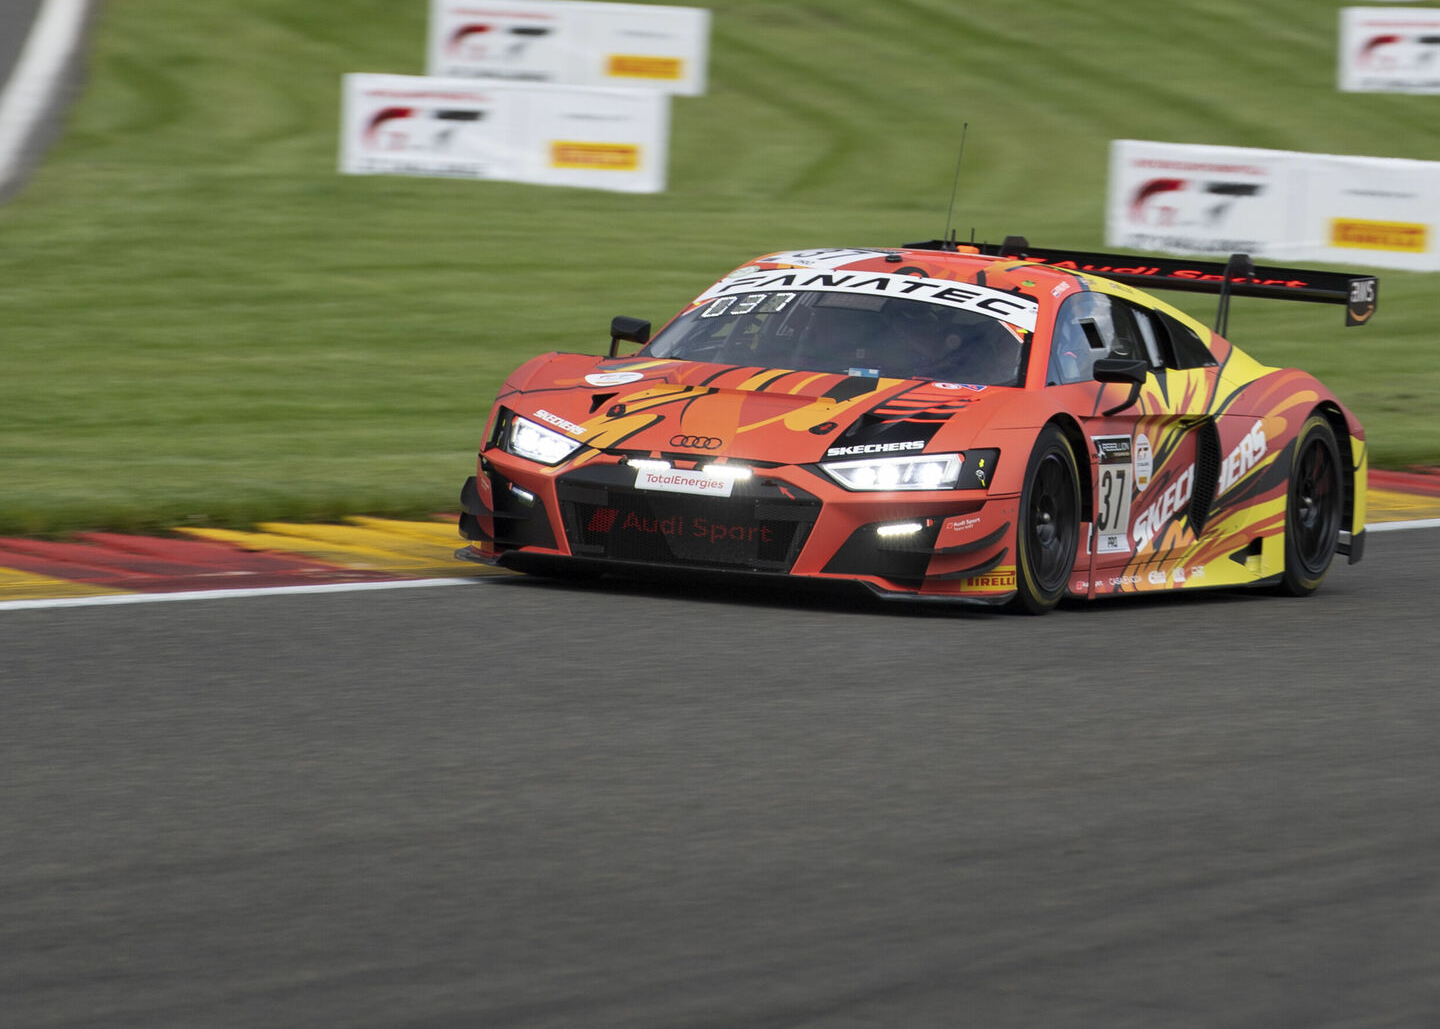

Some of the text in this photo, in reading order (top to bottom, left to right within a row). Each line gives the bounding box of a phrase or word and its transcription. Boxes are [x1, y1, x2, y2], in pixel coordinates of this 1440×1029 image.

[1050, 260, 1160, 276] Audi
[701, 292, 797, 319] 037
[718, 274, 1026, 316] FANATEC
[827, 440, 925, 457] SKECHERS
[646, 473, 725, 490] TotalEnergies
[1097, 470, 1126, 531] 37
[623, 511, 774, 544] Audi Sport
